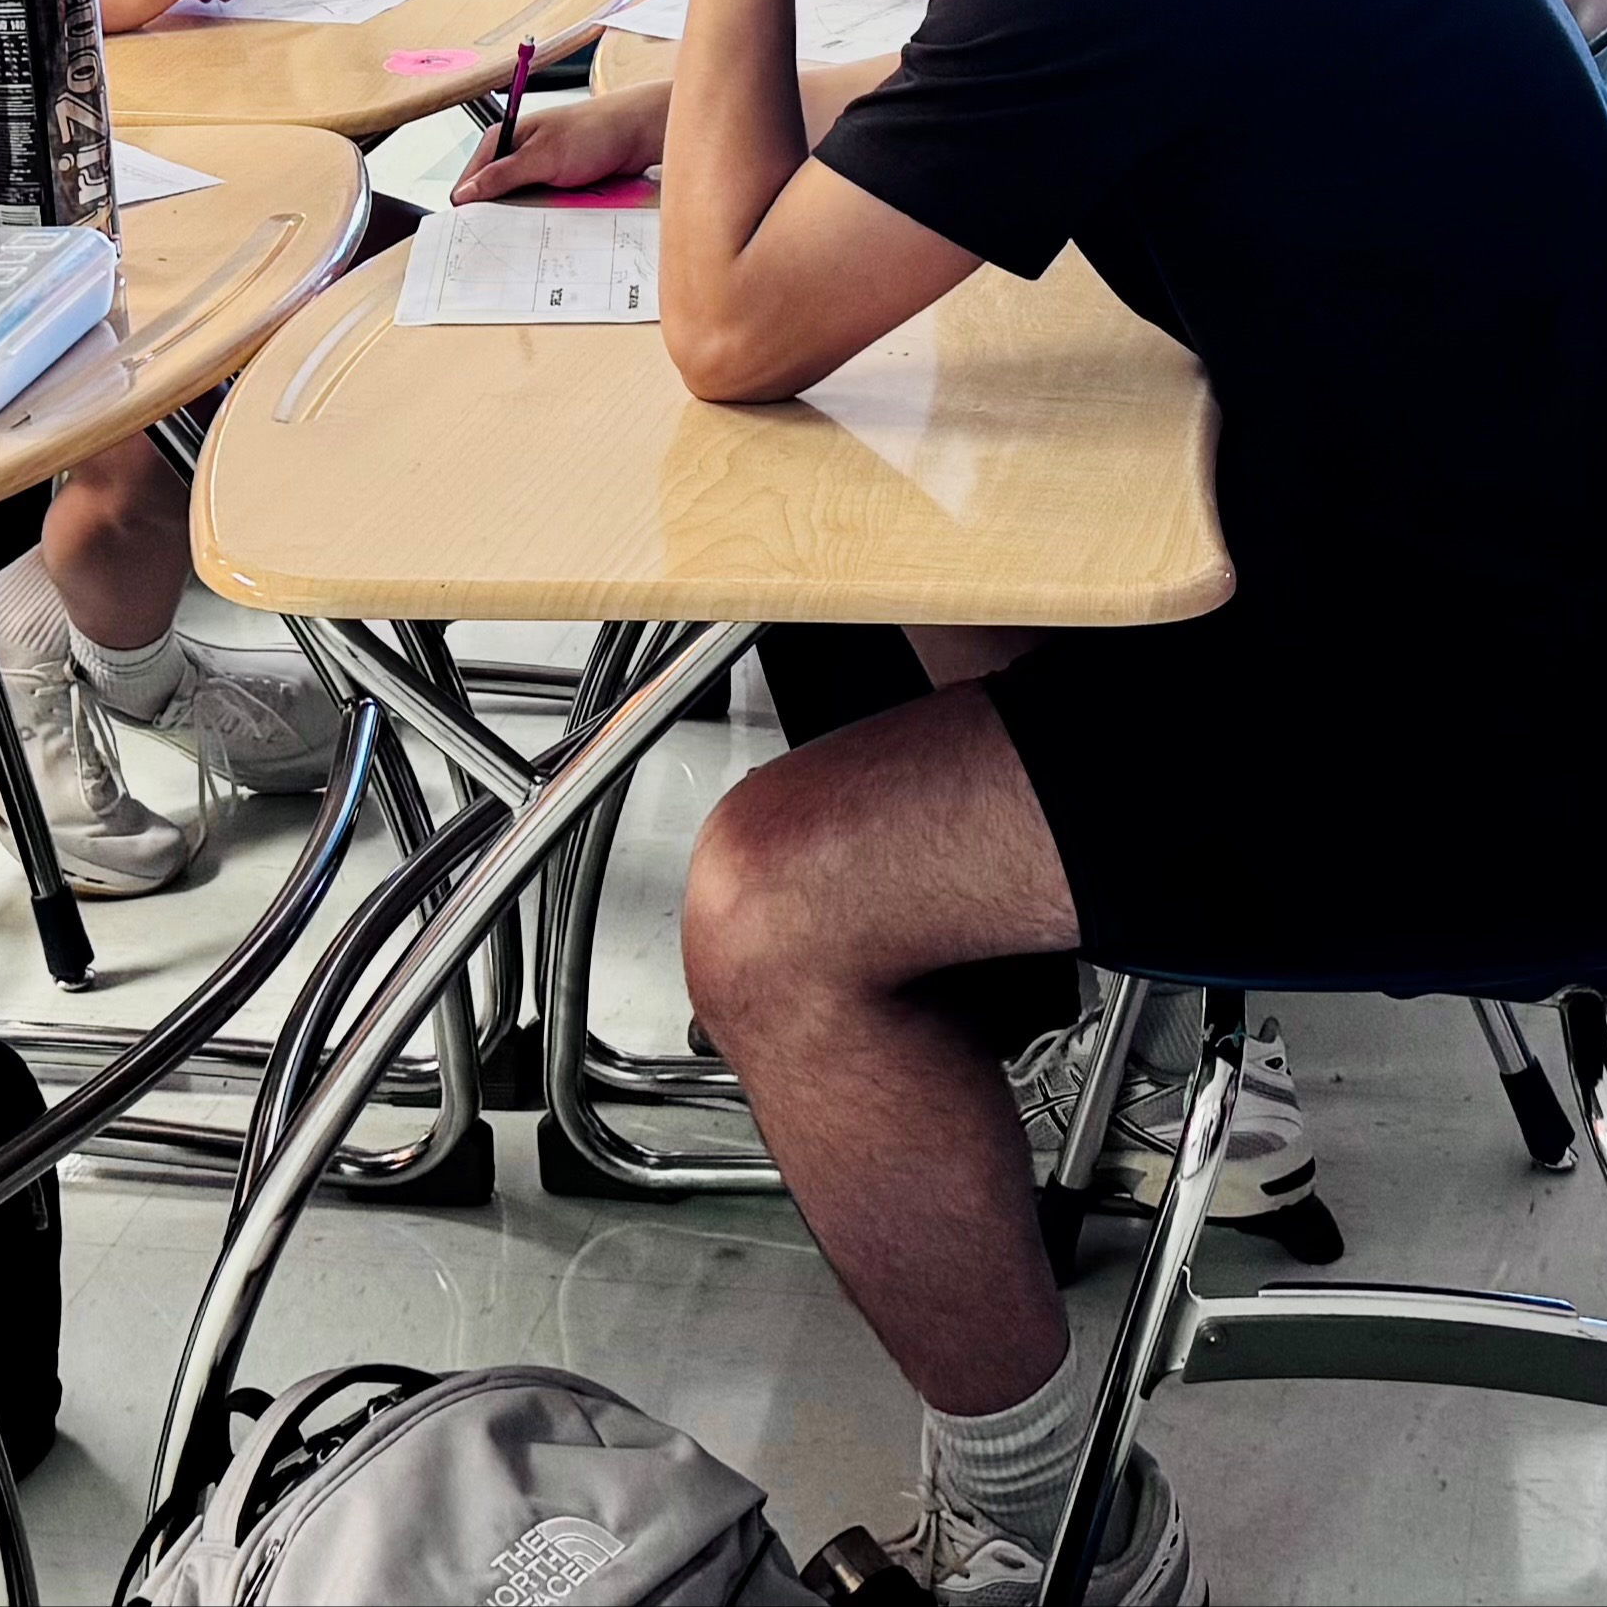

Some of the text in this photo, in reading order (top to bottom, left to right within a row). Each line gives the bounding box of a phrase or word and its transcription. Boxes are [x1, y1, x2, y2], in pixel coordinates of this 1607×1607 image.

[487, 1546, 567, 1606] ORTH
[490, 1528, 549, 1576] THE
[518, 1561, 589, 1606] ACE
